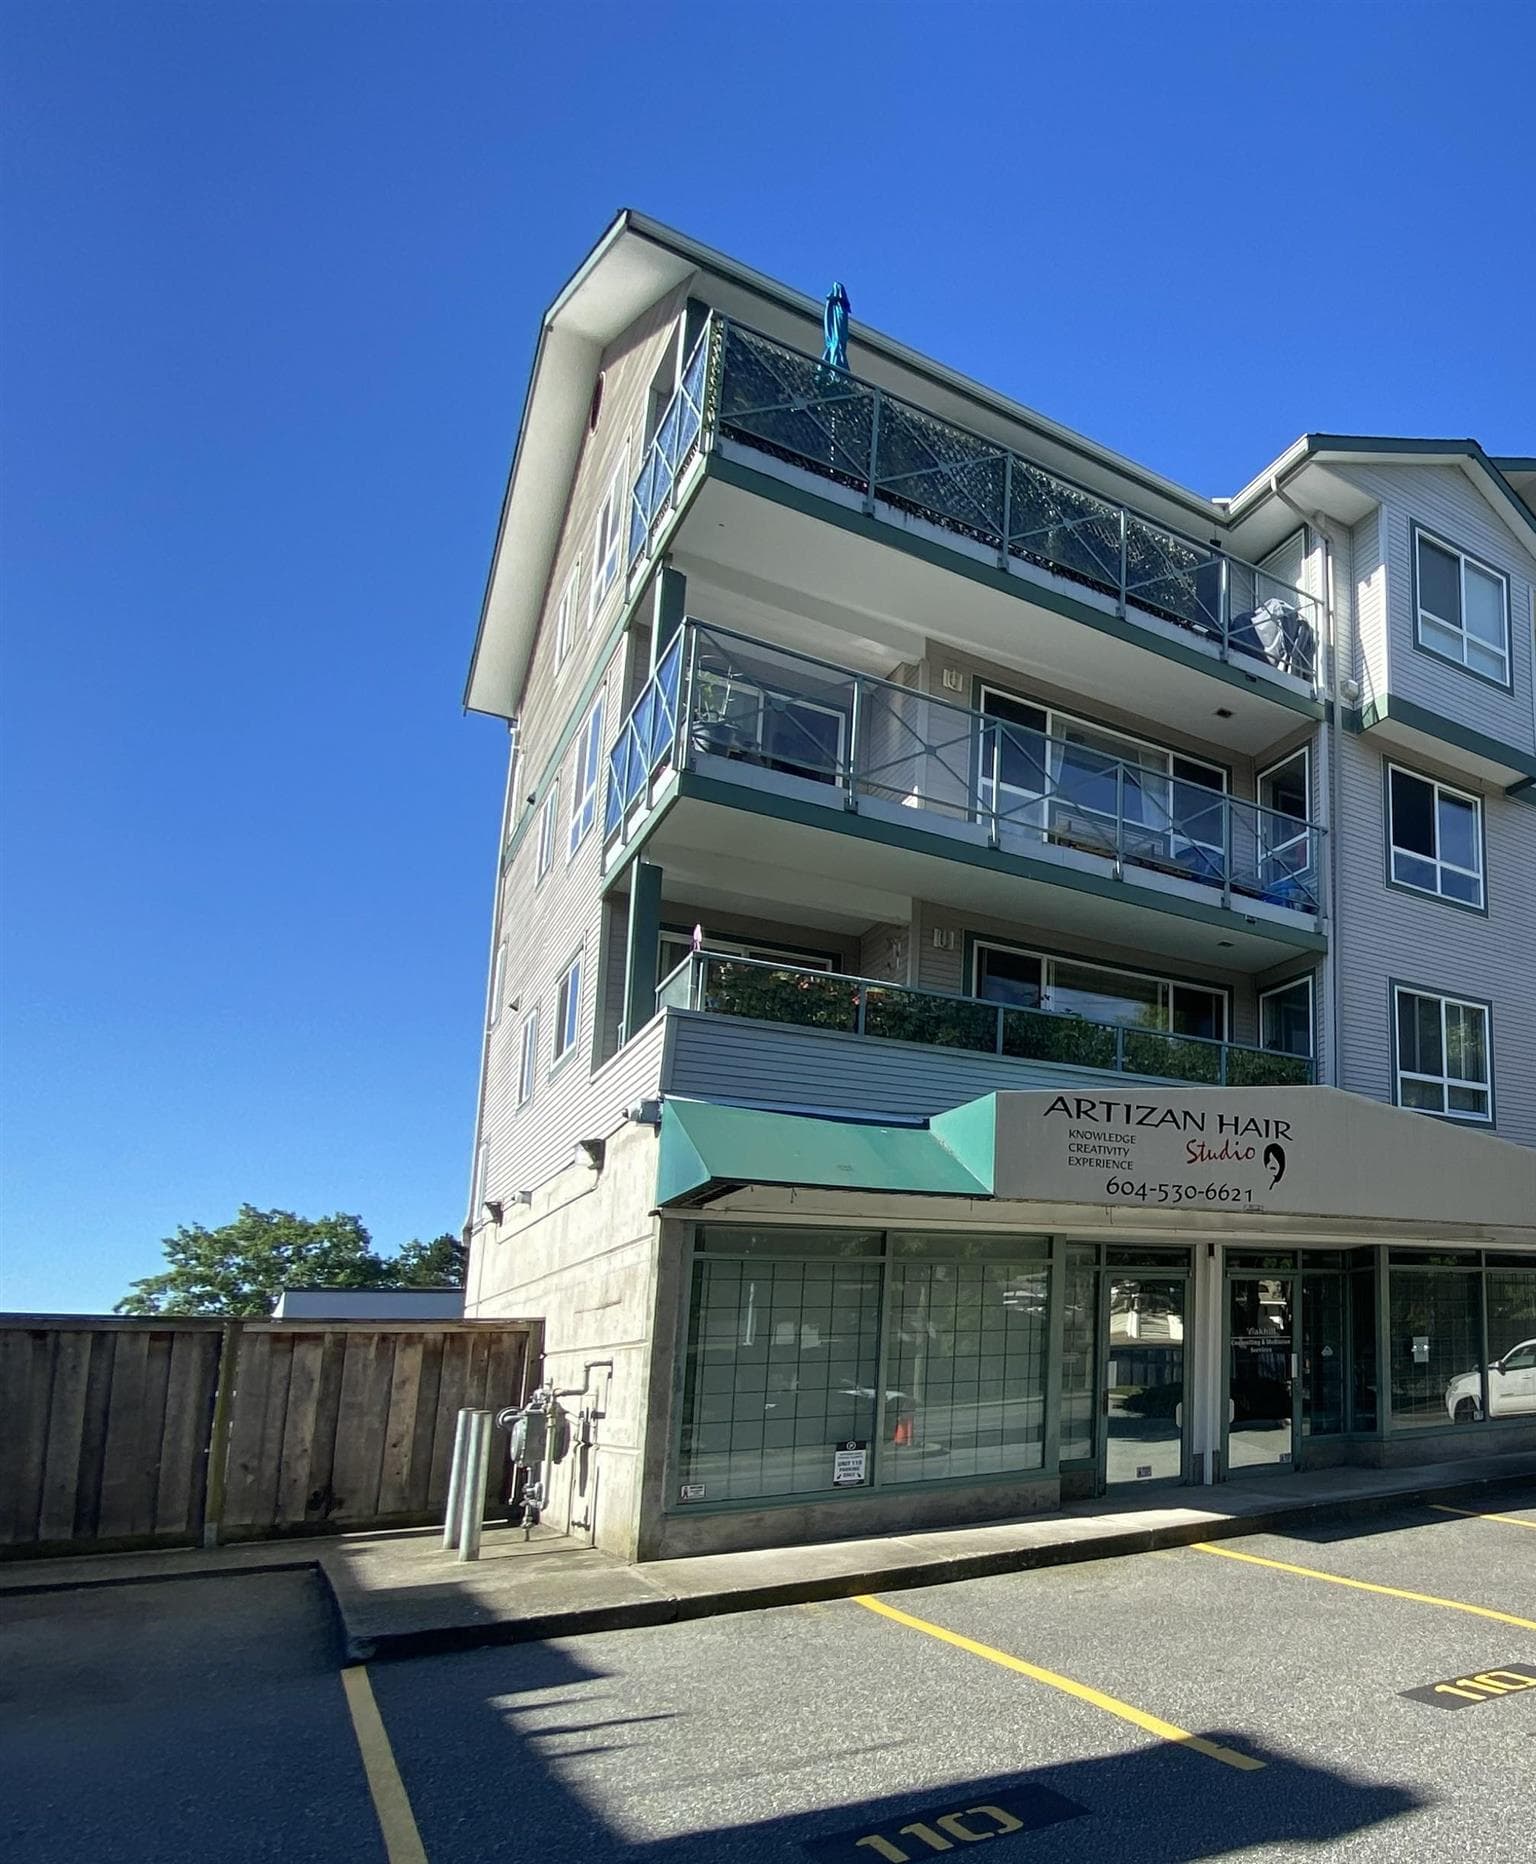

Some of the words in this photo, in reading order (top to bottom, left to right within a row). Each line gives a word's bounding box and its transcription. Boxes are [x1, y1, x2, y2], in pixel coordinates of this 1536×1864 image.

[1043, 1096, 1205, 1131] ARTIZAN
[1217, 1114, 1293, 1141] HAIR
[1068, 1129, 1136, 1144] KNOWLEDGE
[1068, 1142, 1130, 1158] CREATIVITY
[1186, 1139, 1256, 1164] Studio
[1068, 1156, 1134, 1170] EXPERIENCE
[1106, 1175, 1253, 1203] 604-530-6621
[855, 1805, 1024, 1863] 110
